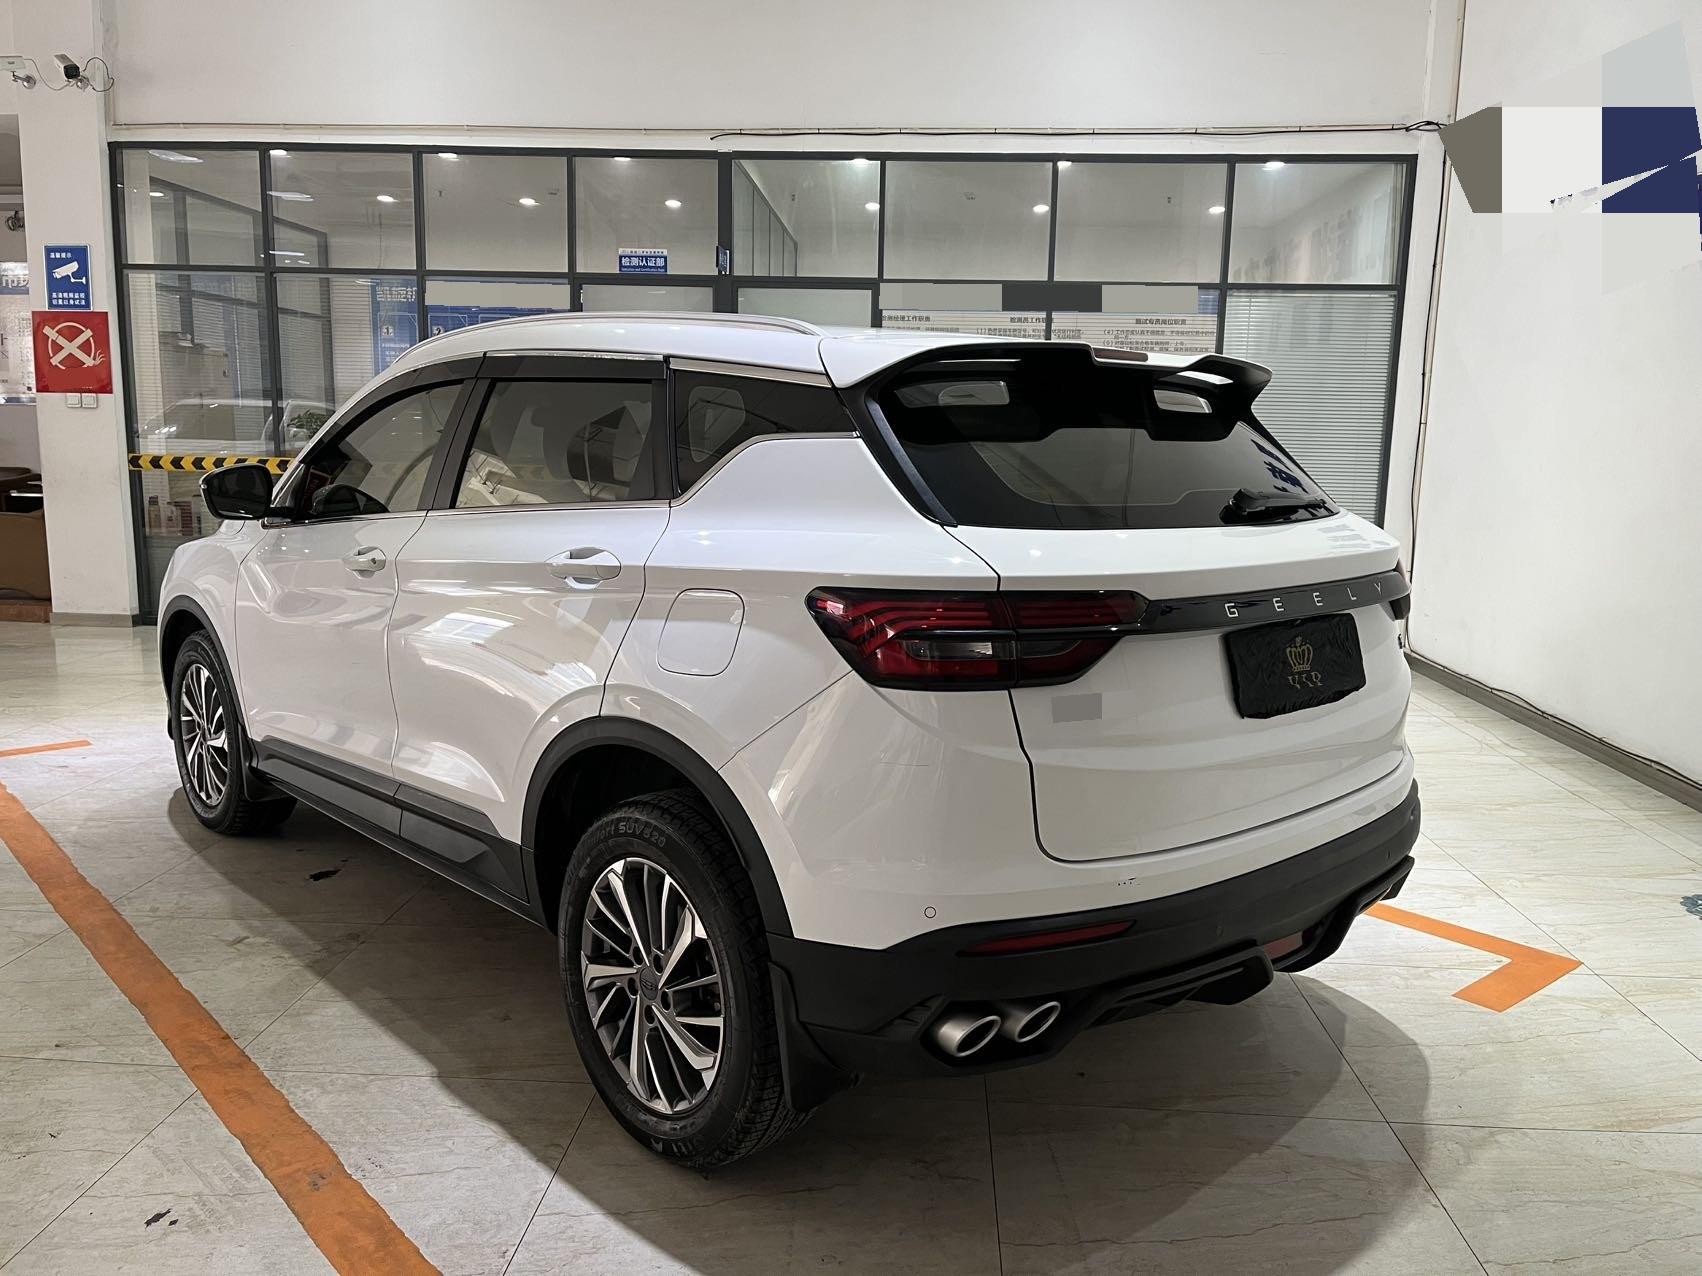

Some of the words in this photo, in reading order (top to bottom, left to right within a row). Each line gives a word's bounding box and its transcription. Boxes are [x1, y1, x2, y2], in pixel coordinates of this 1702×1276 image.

[621, 256, 665, 267] 检测认证部
[1224, 581, 1383, 618] GEELY
